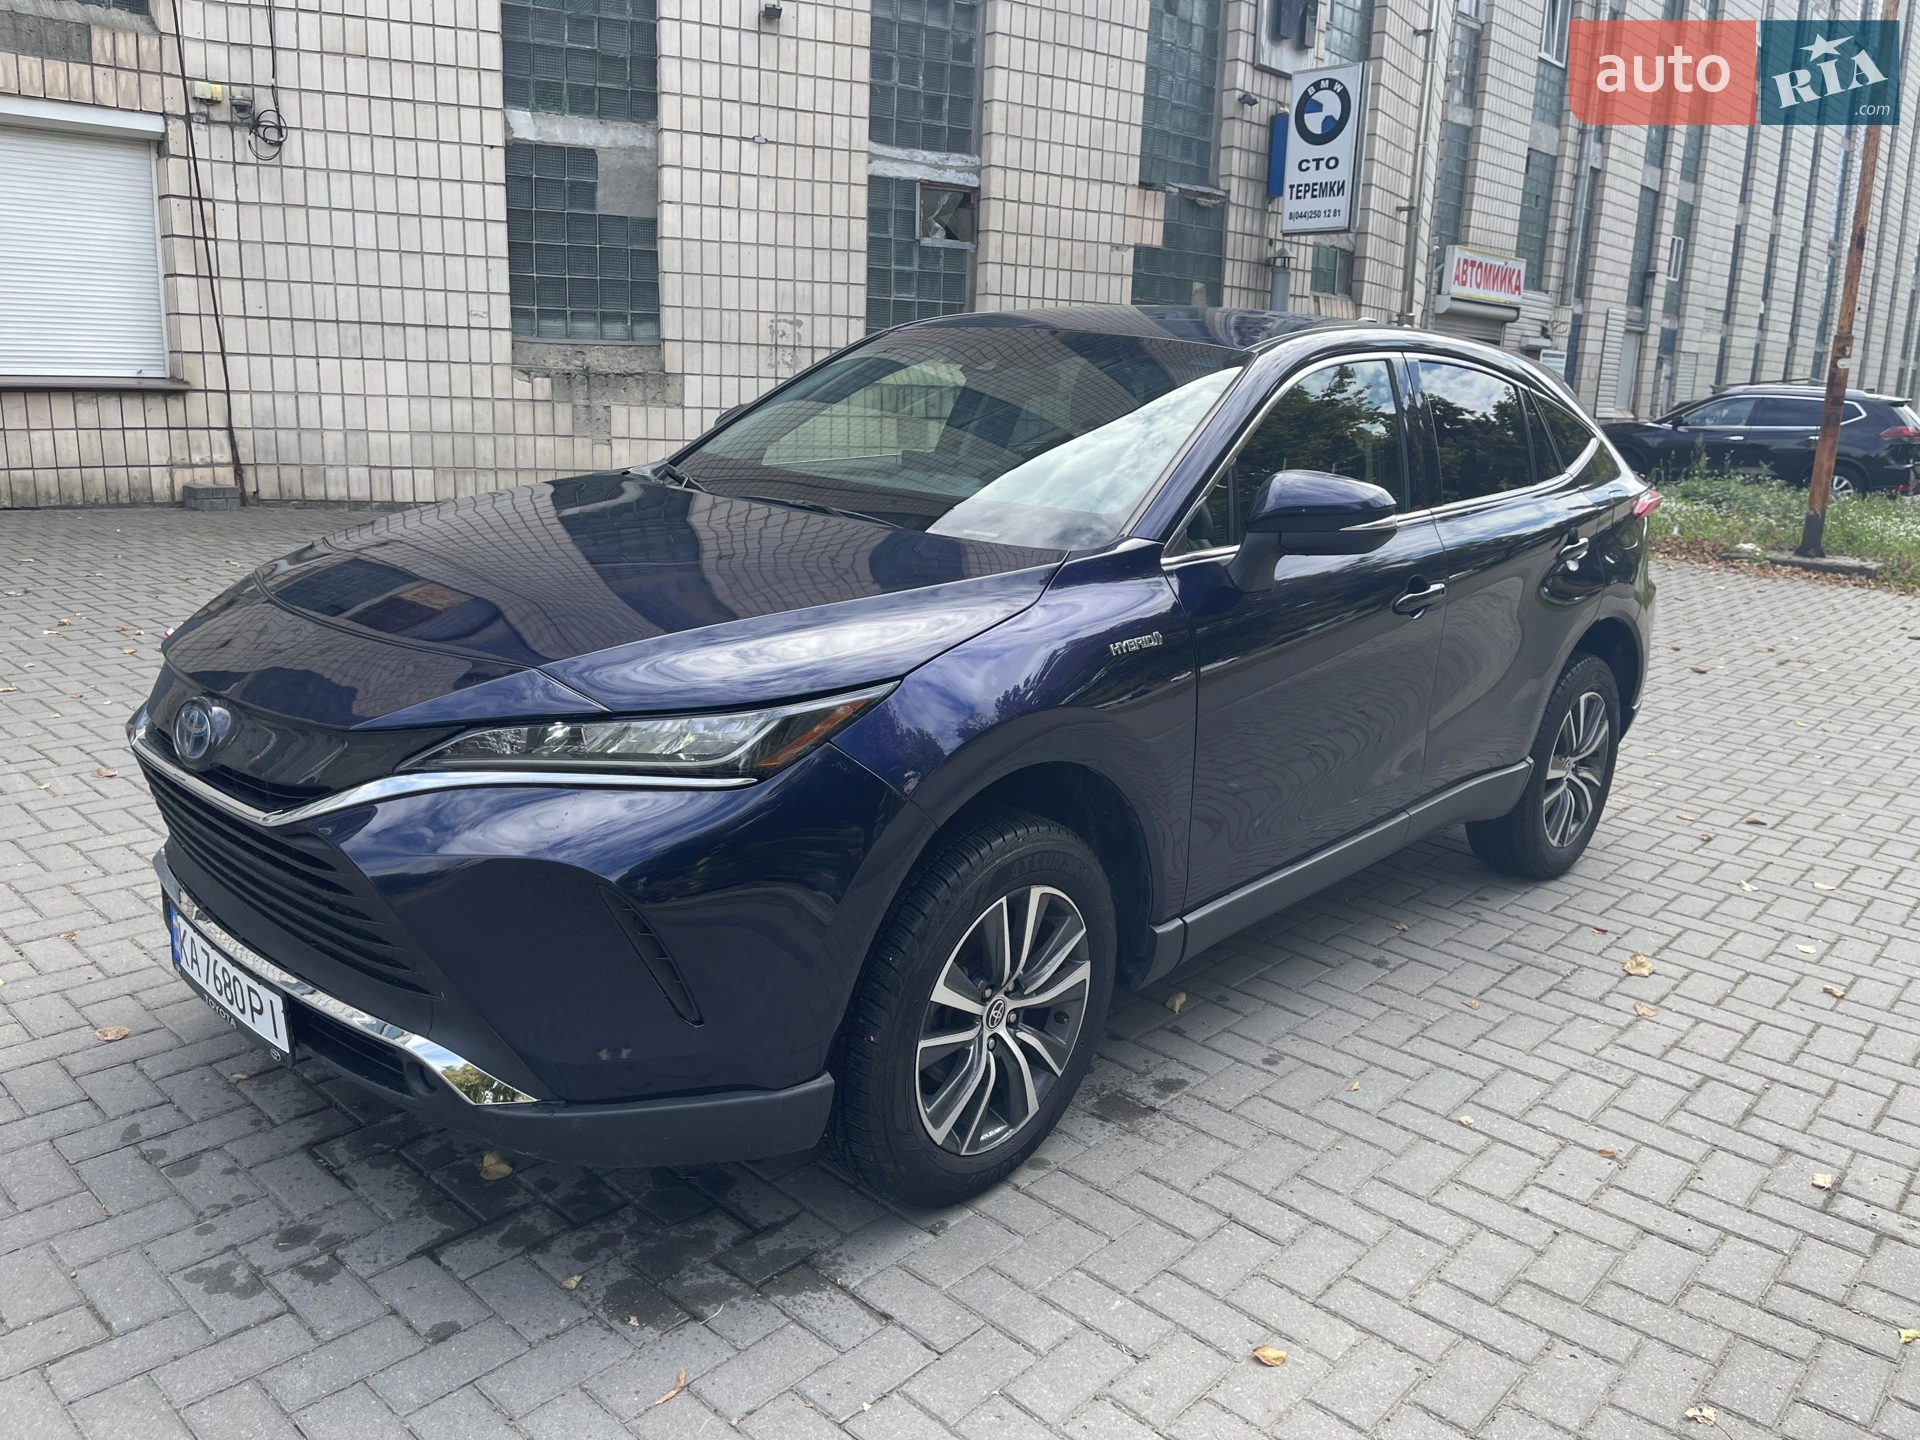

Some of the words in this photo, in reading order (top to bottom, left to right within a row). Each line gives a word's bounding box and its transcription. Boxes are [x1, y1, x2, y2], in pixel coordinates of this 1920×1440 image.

[1307, 79, 1343, 96] BMW
[1298, 156, 1340, 172] СТО
[1289, 180, 1345, 200] ТЕРЕМКИ
[1288, 210, 1322, 222] 8(044)250
[1323, 209, 1331, 218] 12
[1333, 208, 1341, 217] 81
[1453, 257, 1521, 296] АВТОМИЙКА
[1109, 634, 1155, 656] HYBRID
[203, 994, 237, 1029] TOYOTA
